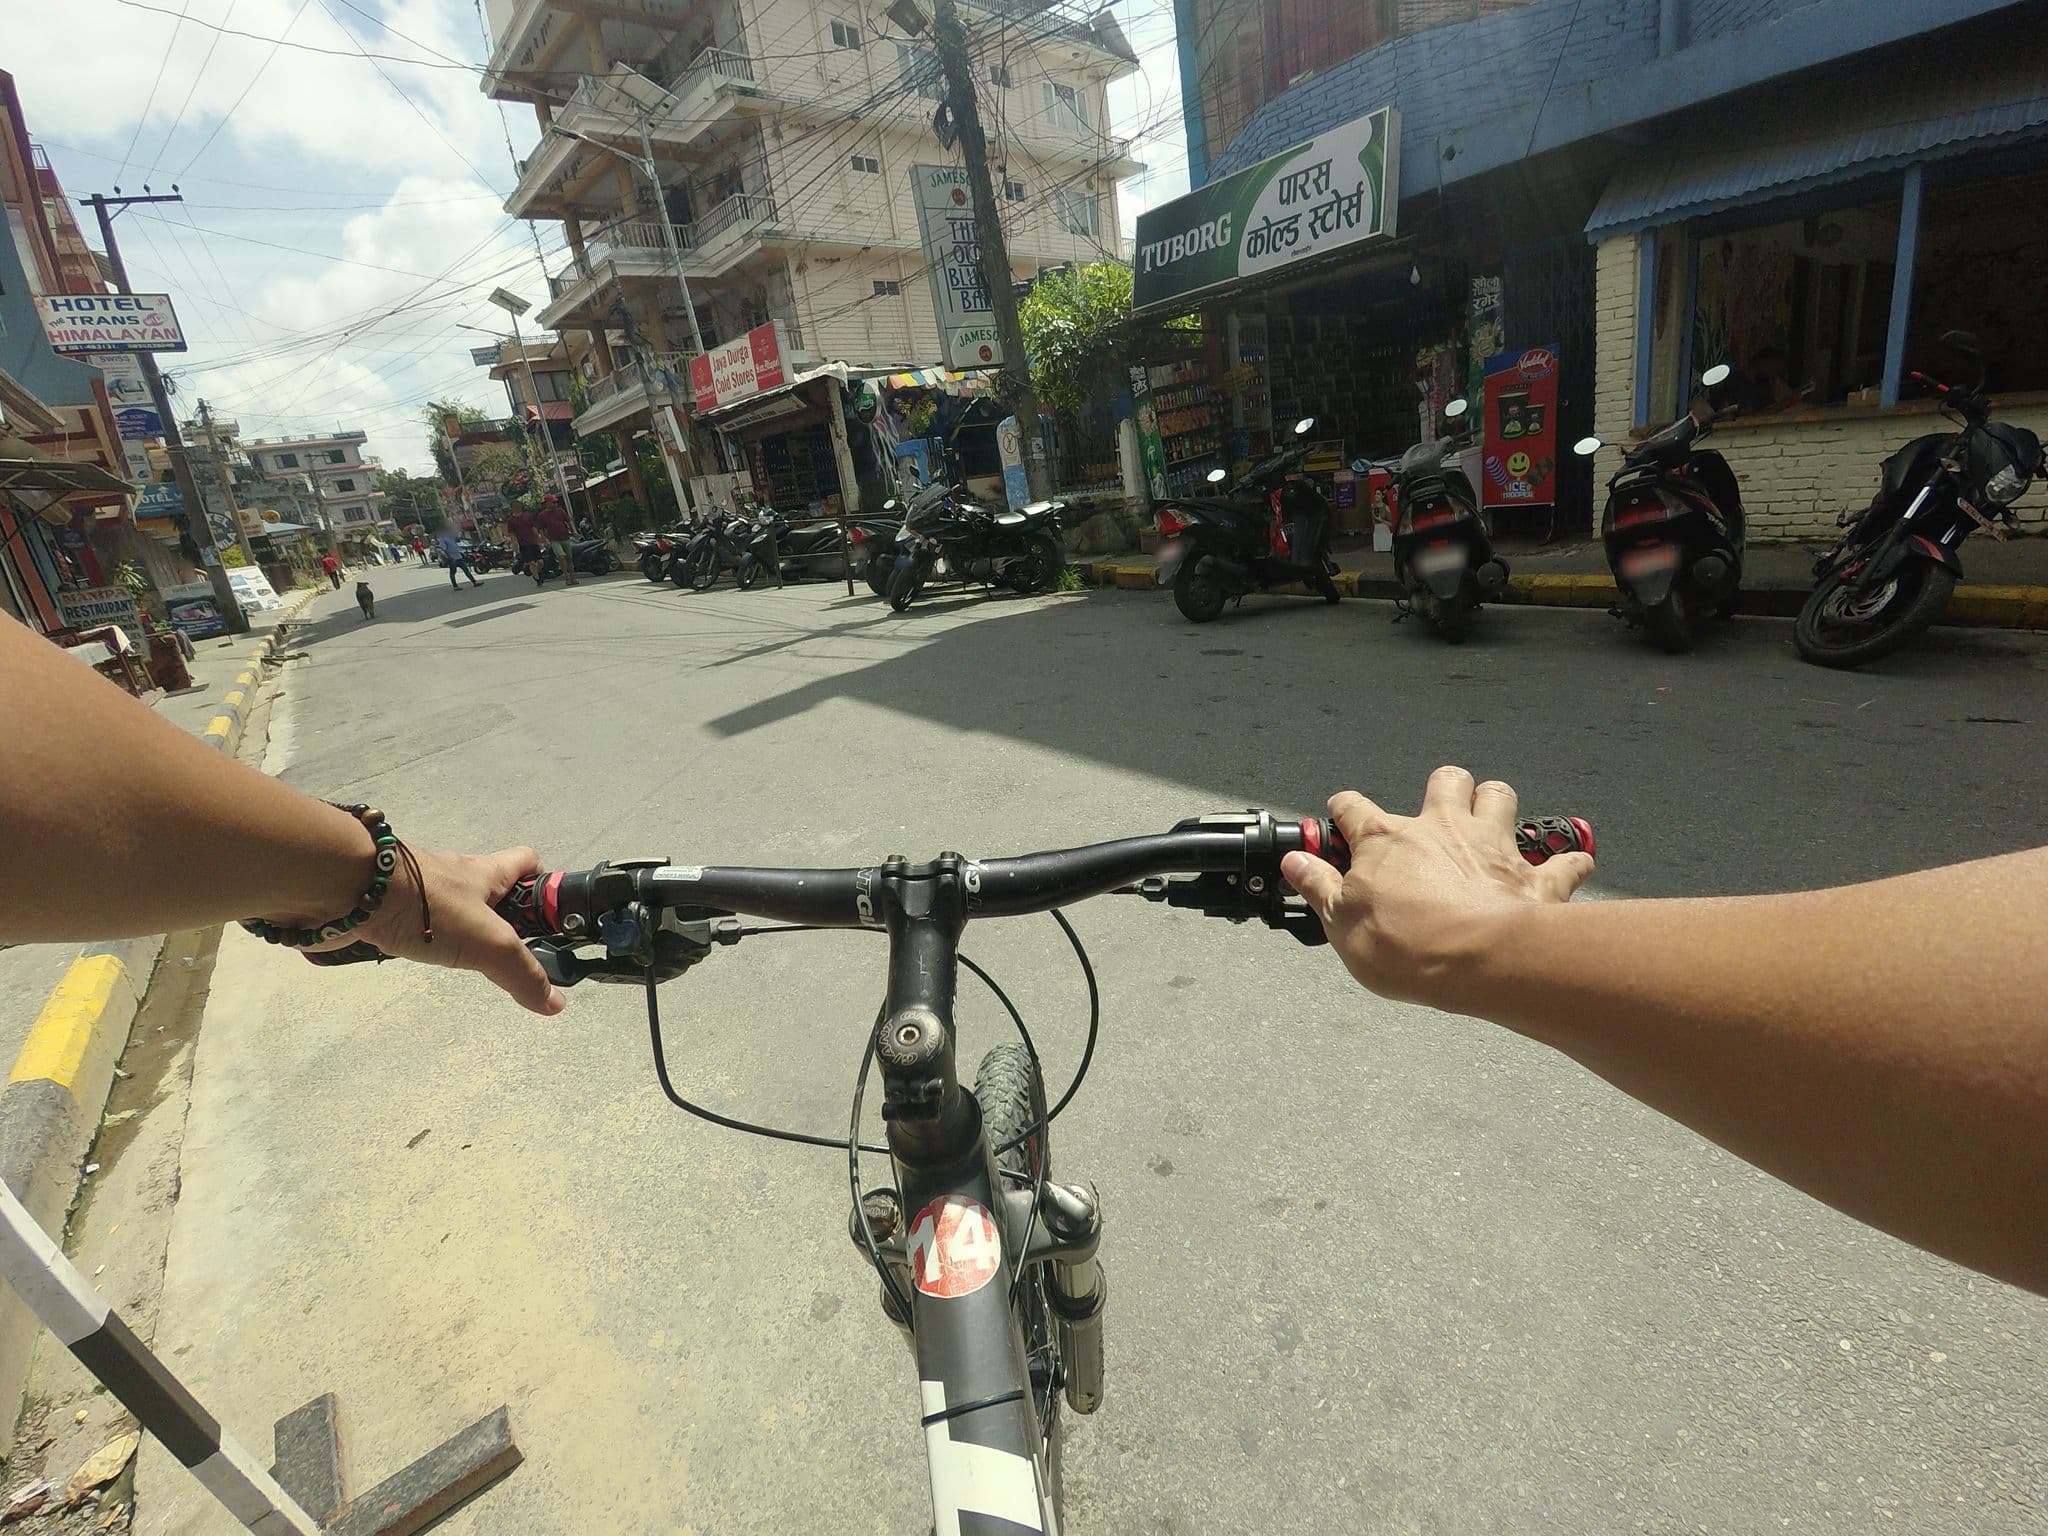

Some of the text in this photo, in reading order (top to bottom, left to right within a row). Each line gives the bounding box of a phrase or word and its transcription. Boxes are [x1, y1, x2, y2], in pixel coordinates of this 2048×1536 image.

[930, 171, 971, 188] JAMES
[1278, 158, 1333, 206] पारस
[1246, 181, 1364, 259] कोल्ड स्टोर्स
[1142, 212, 1232, 274] TUBORG
[948, 267, 979, 287] BLU
[51, 298, 154, 312] HOTEL
[49, 315, 140, 328] THE TRANS
[48, 327, 178, 342] HIMALAYAN
[960, 330, 1000, 347] JAMESO
[713, 345, 750, 374] Jaya Durga
[715, 376, 732, 394] Cold
[731, 368, 755, 388] Stores
[1509, 482, 1526, 491] ICE
[142, 494, 173, 504] OTEL
[65, 599, 134, 619] RESTAURANT
[879, 1018, 919, 1066] GIANT
